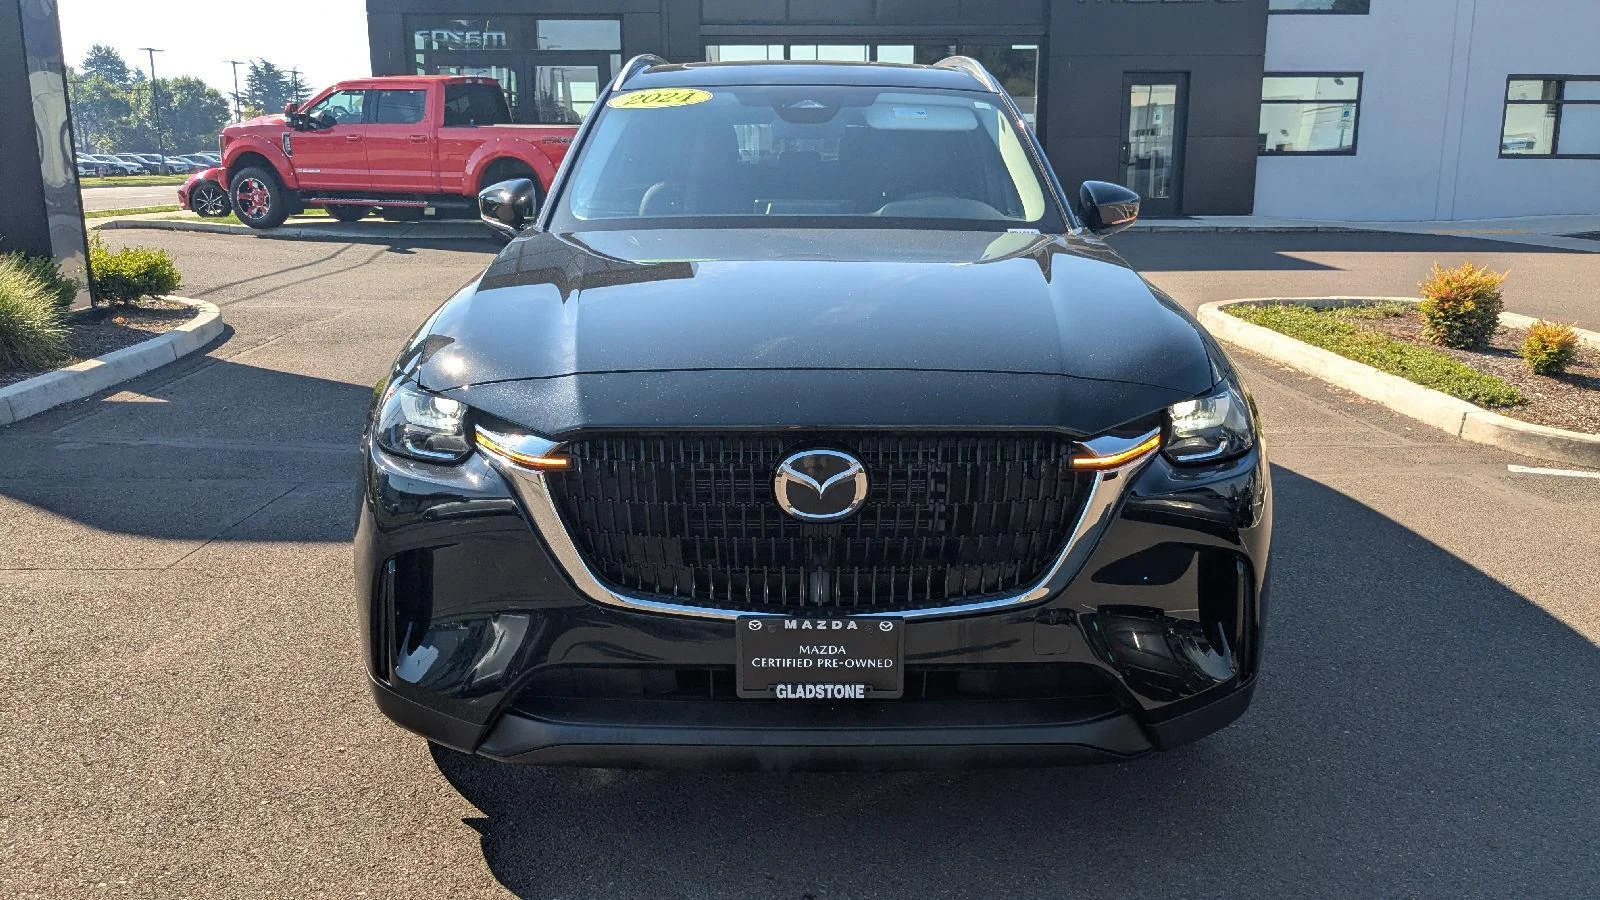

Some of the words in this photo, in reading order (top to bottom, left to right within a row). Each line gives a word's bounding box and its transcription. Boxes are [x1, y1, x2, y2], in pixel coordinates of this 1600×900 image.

[623, 92, 696, 106] 2024
[784, 619, 858, 630] MAZDA
[799, 645, 846, 655] MAZDA
[751, 657, 813, 668] CERTIFIED
[817, 658, 893, 668] PRE-OWNED
[776, 684, 865, 699] GLADSTONE
